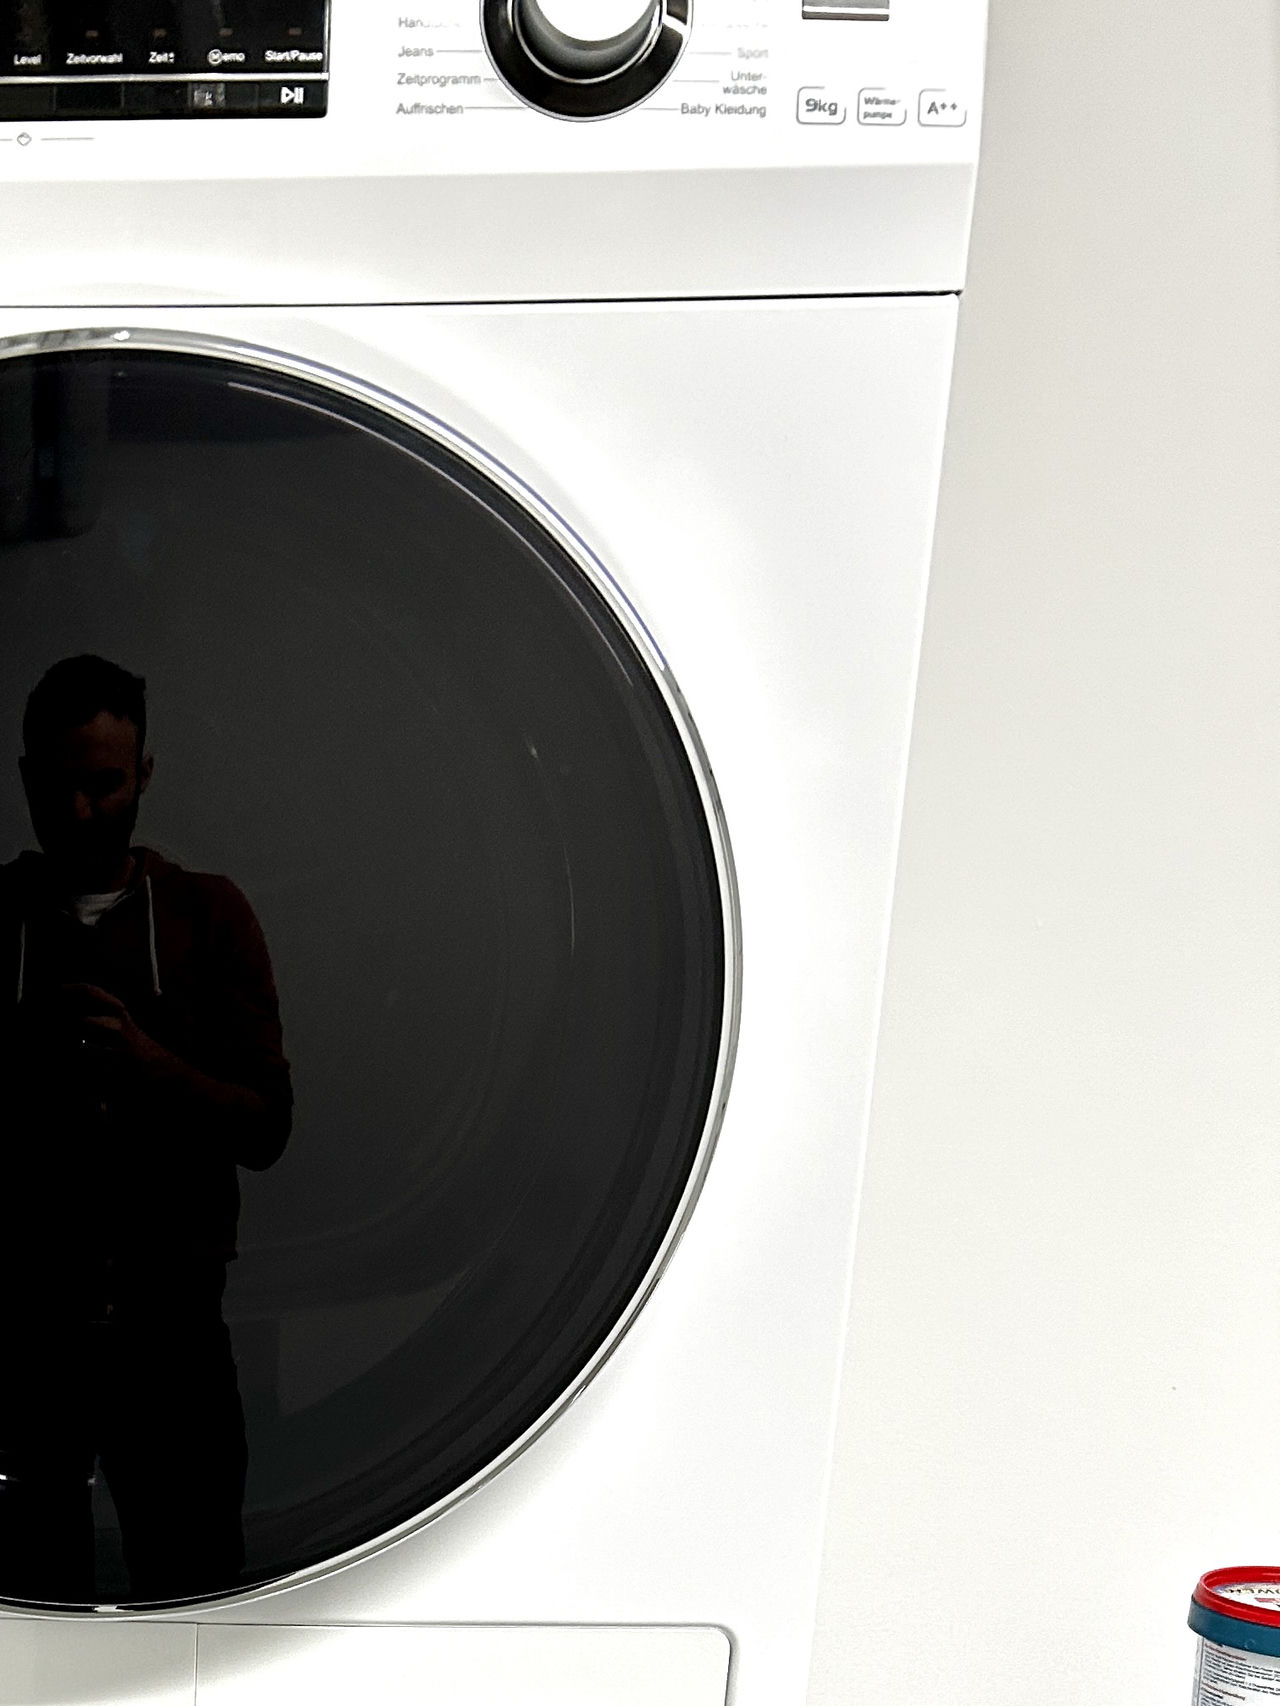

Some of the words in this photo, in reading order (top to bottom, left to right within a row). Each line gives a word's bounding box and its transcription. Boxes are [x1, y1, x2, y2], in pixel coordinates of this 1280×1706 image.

[264, 50, 323, 62] Start/Pause
[398, 46, 434, 57] Jeans
[737, 47, 768, 60] Sport
[14, 54, 42, 65] Level
[65, 53, 124, 64] Zeitvorwahl
[397, 73, 481, 87] Zeitprogramm
[723, 84, 767, 95] wäsche
[396, 102, 464, 114] Auffrischen
[681, 102, 711, 117] Baby
[715, 103, 767, 119] Kleidung
[805, 98, 838, 116] 9kg
[927, 101, 958, 115] A++
